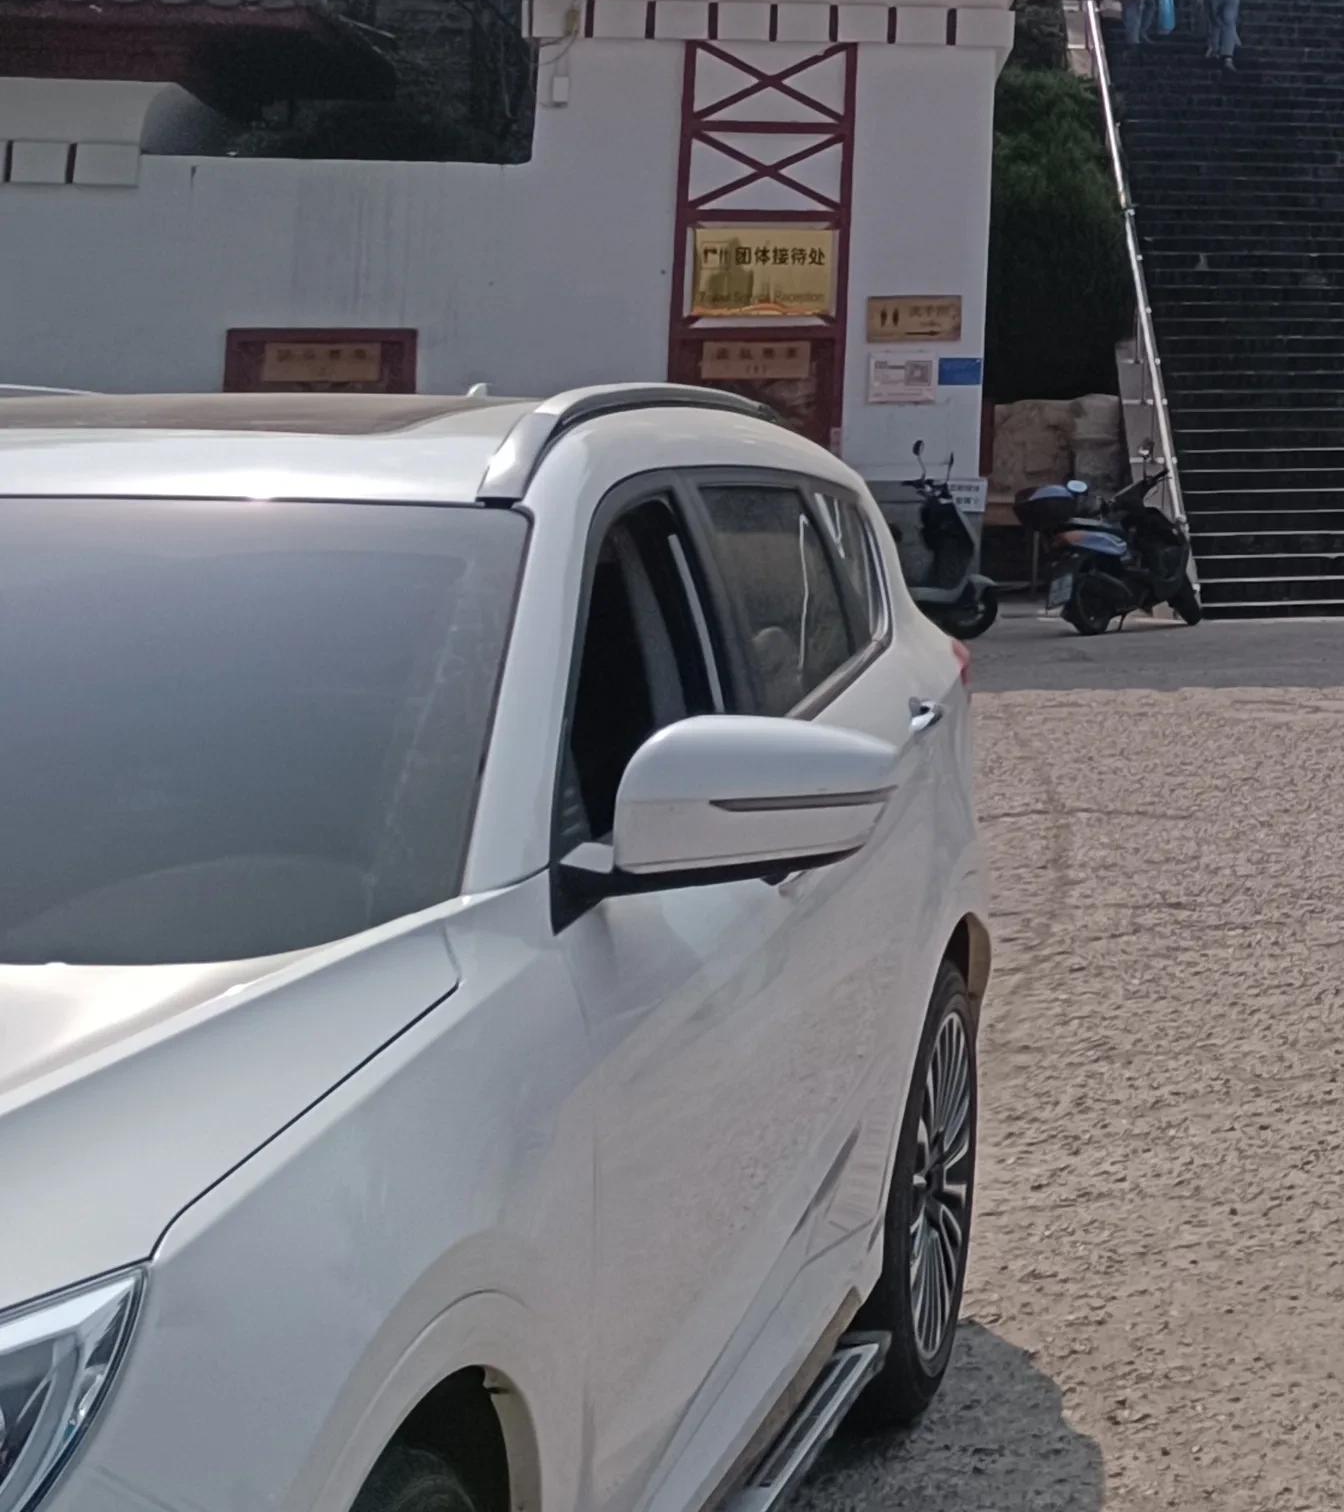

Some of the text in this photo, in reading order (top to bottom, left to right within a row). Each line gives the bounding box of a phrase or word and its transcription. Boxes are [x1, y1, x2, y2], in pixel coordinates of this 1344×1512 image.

[735, 245, 826, 266] 团体接待处
